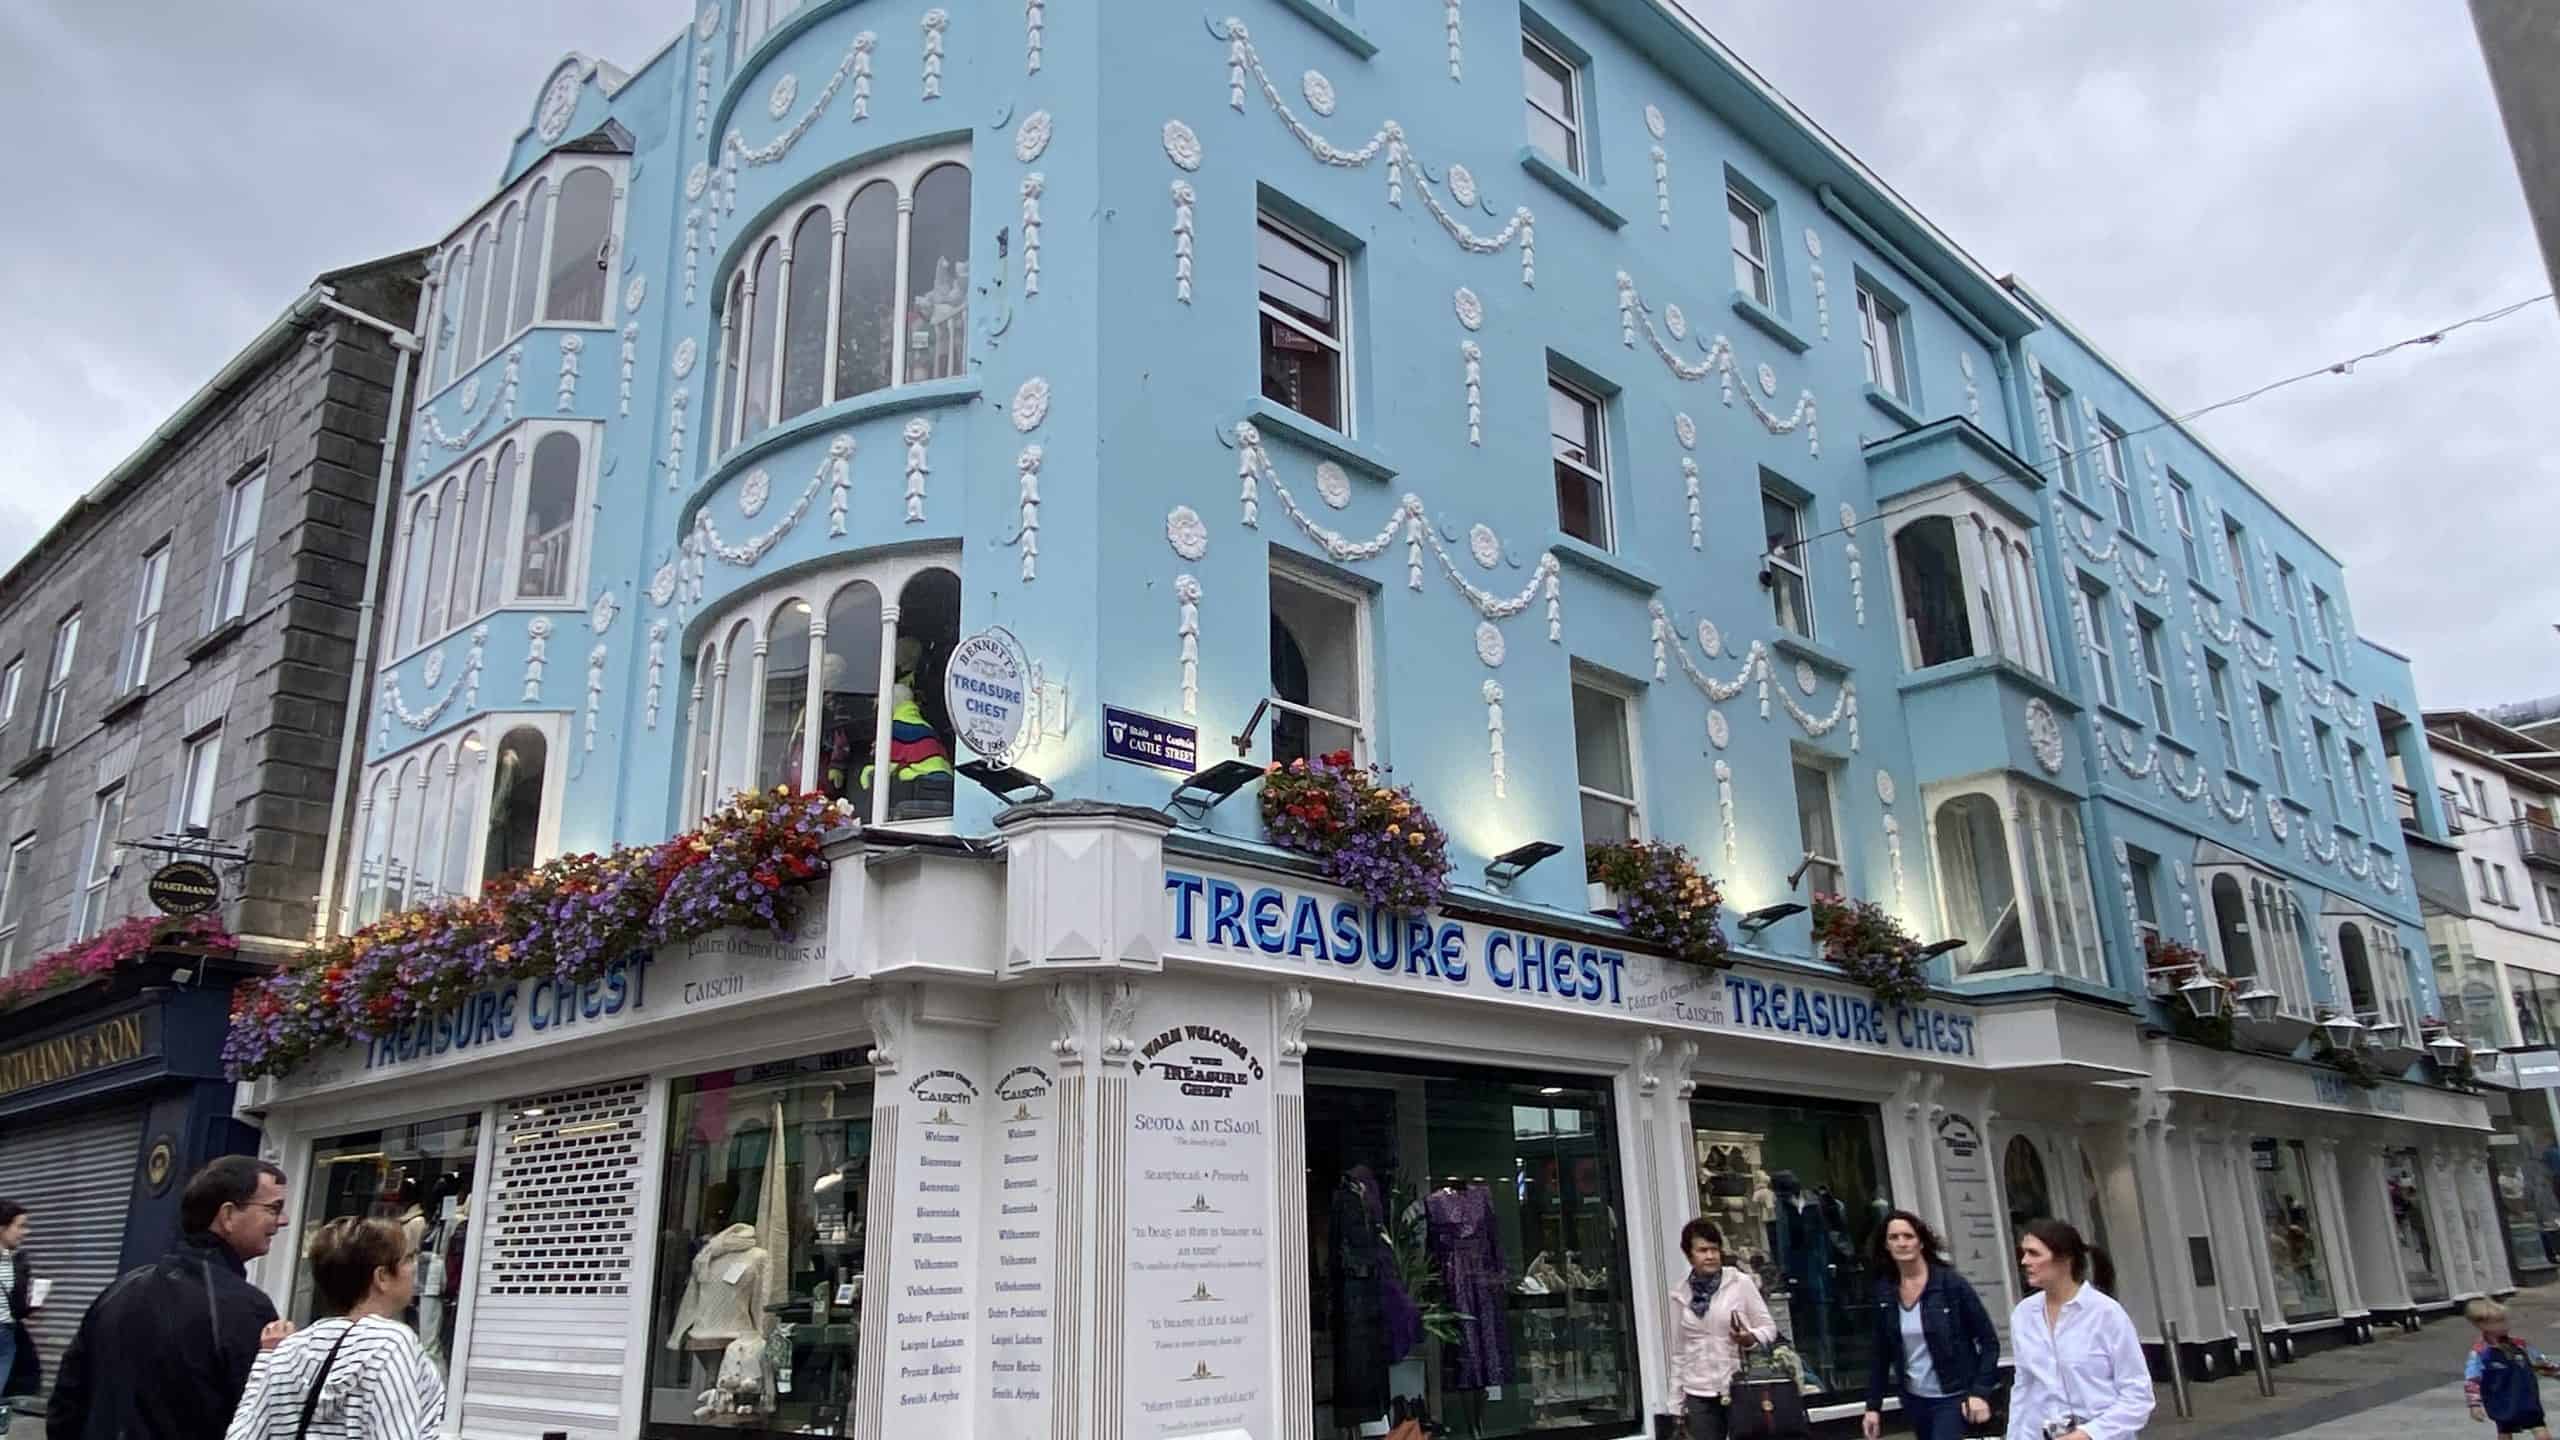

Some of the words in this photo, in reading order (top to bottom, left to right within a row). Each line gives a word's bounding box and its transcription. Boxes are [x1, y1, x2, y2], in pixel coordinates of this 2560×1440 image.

[952, 673, 1021, 704] TREASURE
[966, 698, 1008, 720] CHEST
[1129, 738, 1162, 756] CASTLE
[1165, 746, 1195, 763] STREET
[1165, 870, 1469, 984] TREASURE
[1486, 929, 1625, 1004] CHEST
[1723, 973, 1888, 1046] TREASURE
[1896, 1000, 1976, 1057] CHEST
[96, 1012, 143, 1066] SON
[1132, 1059, 1145, 1076] A
[1141, 1027, 1183, 1060] WARM
[1184, 1025, 1248, 1060] WELCOME
[1248, 1056, 1264, 1080] TO
[1149, 1063, 1248, 1085] TREASURE
[1180, 1083, 1233, 1098] CHEST
